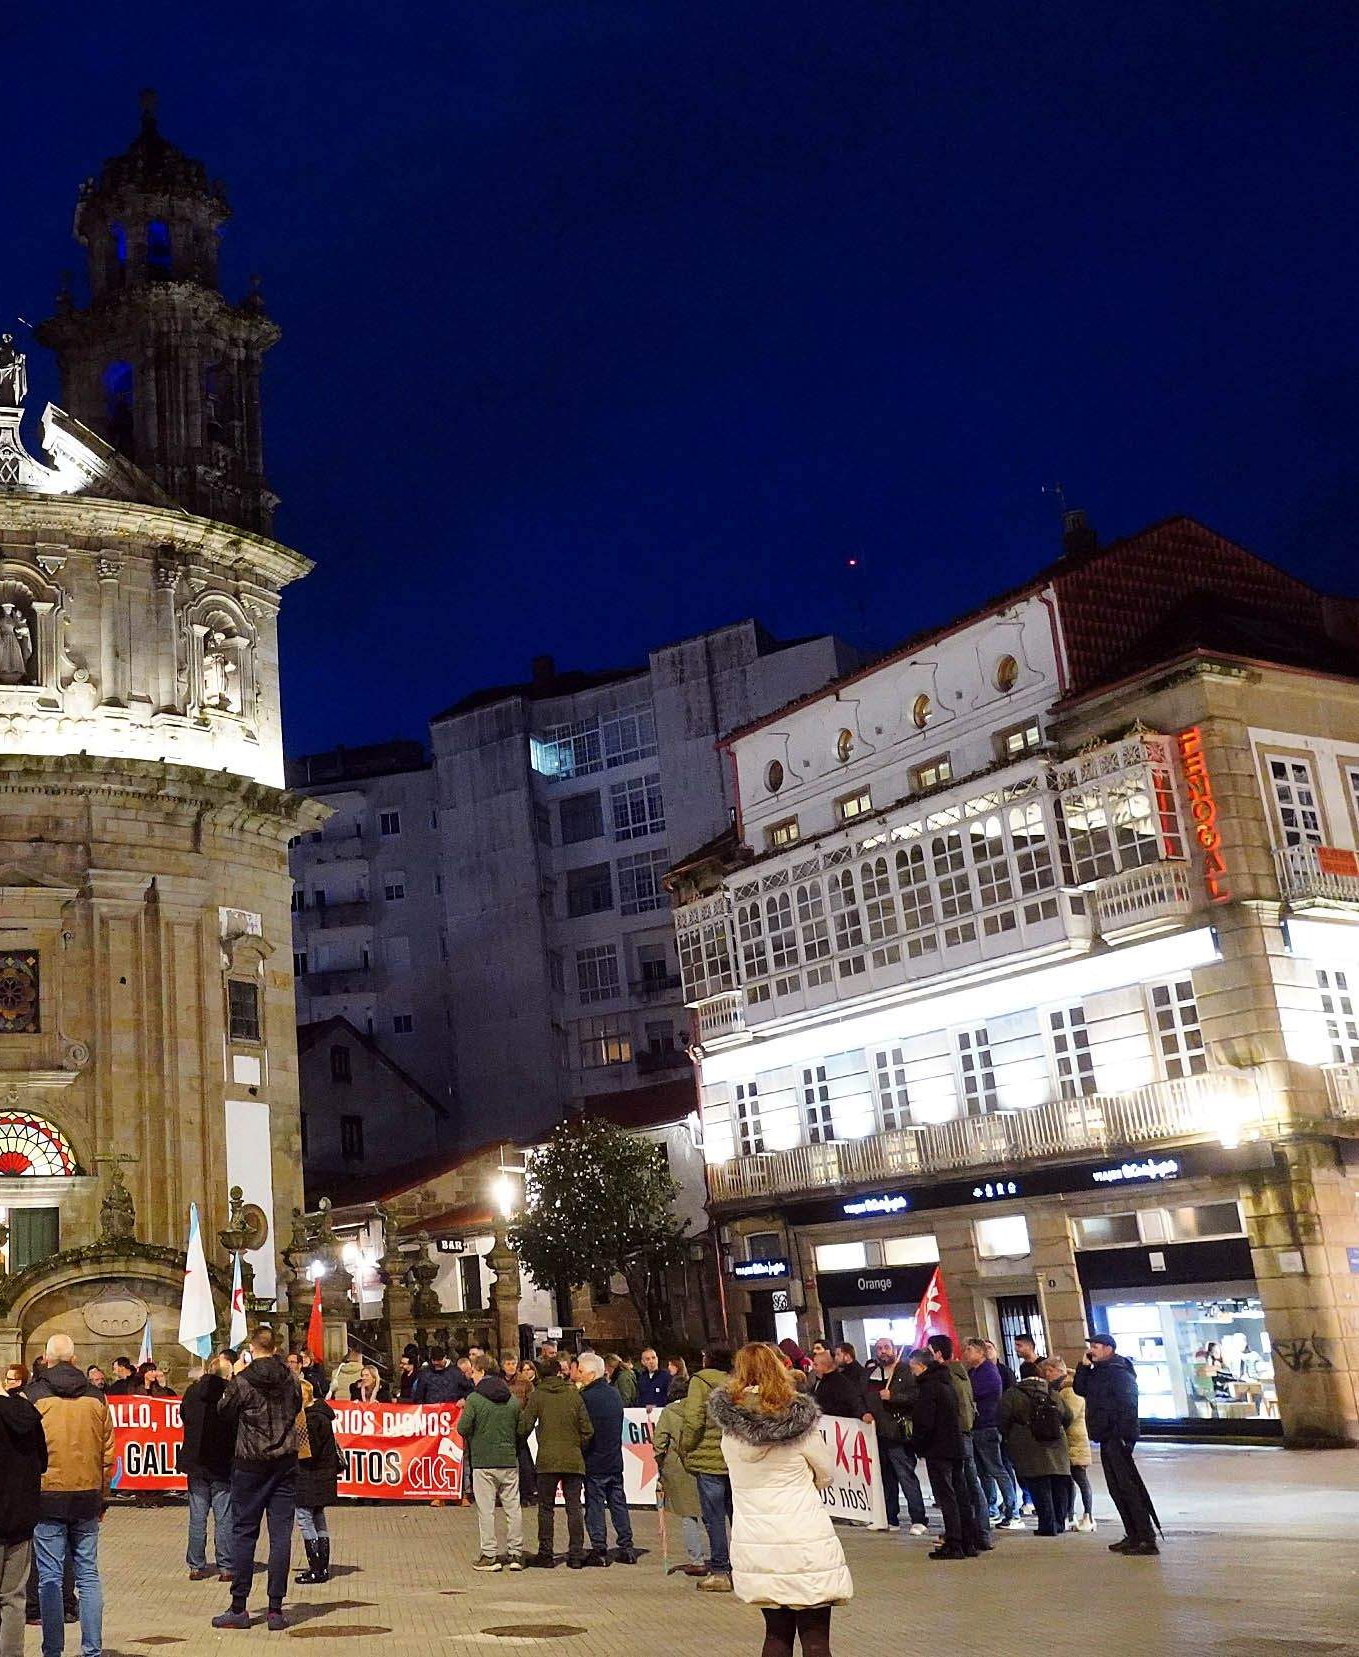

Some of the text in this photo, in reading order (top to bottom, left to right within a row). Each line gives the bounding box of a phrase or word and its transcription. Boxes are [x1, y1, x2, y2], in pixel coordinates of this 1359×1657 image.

[441, 1240, 463, 1251] BAR
[857, 1277, 892, 1292] Orange
[407, 1456, 458, 1489] CIG
[839, 1481, 872, 1512] nós!
